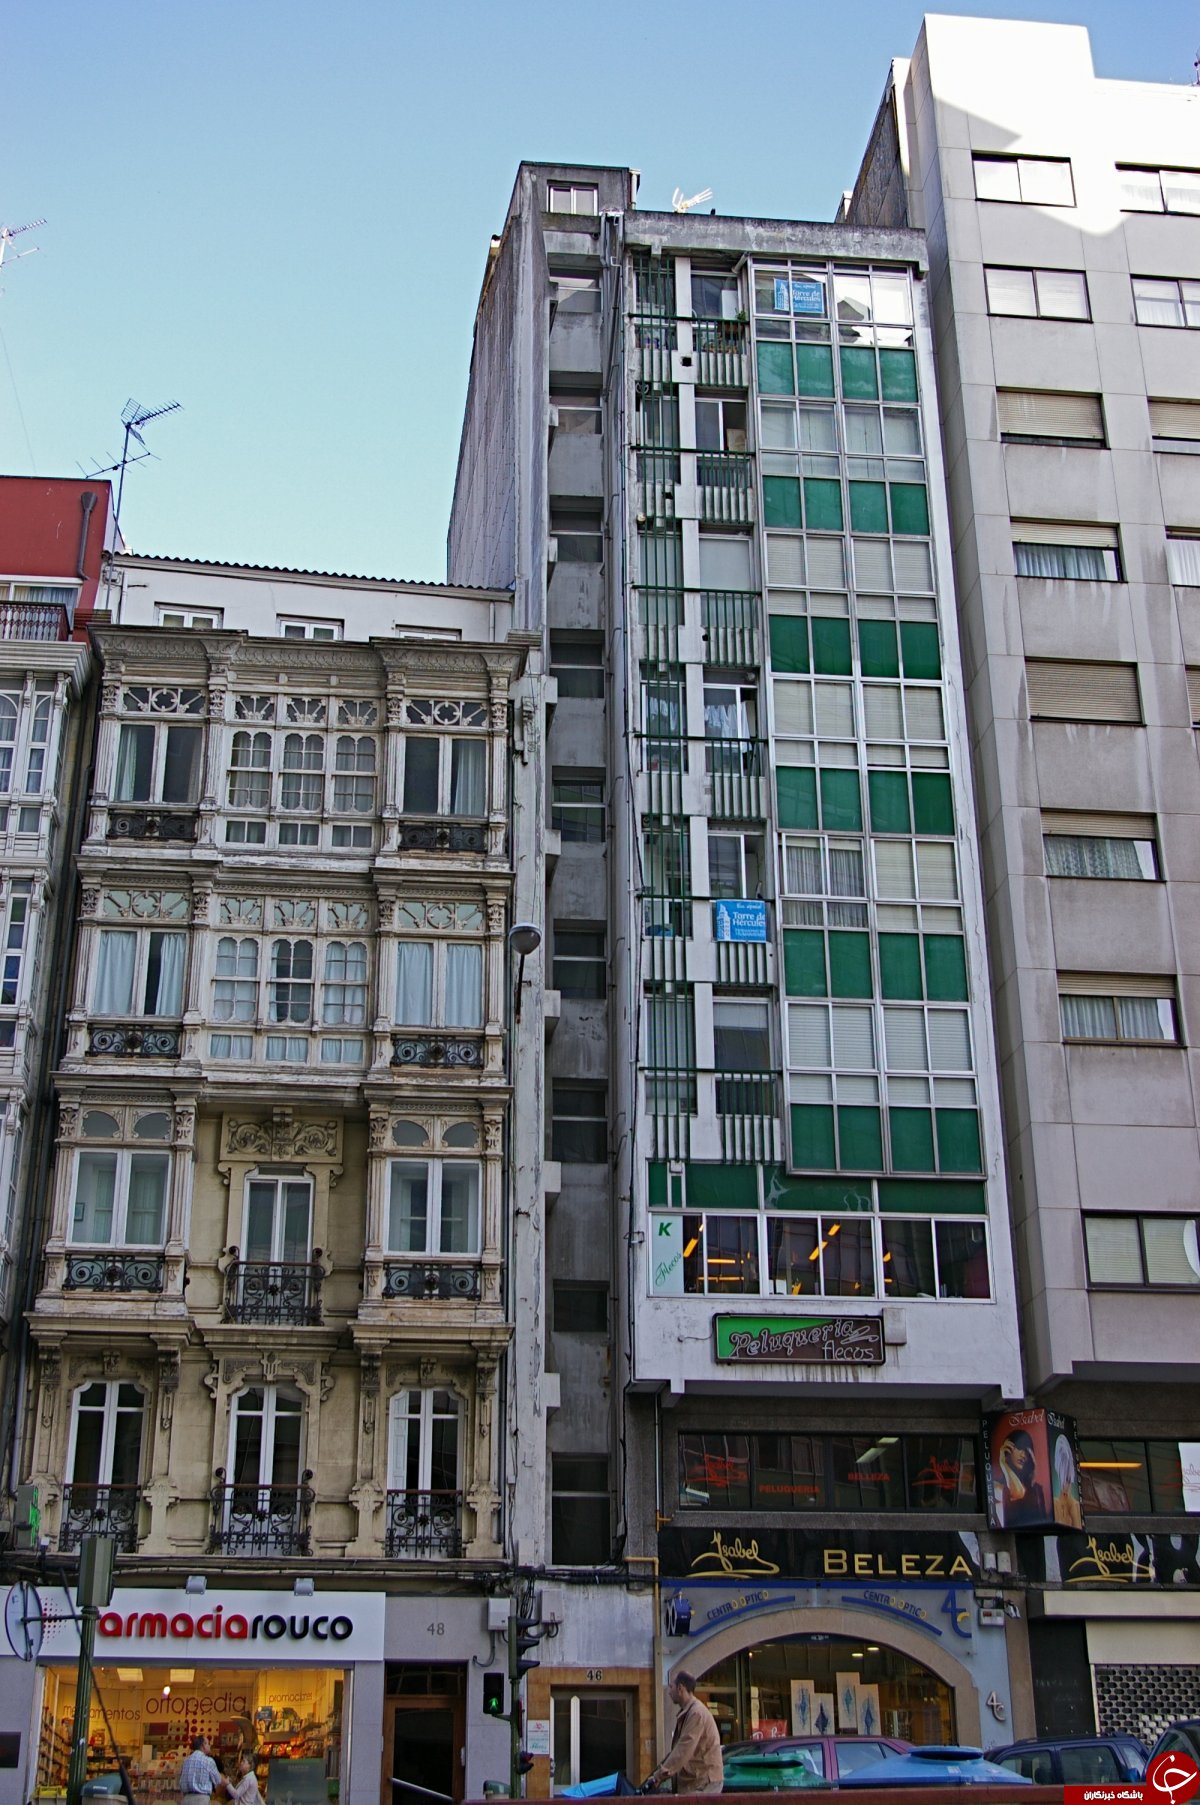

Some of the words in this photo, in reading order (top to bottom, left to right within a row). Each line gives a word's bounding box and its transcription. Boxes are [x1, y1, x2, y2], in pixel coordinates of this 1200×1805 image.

[732, 911, 755, 920] Torre
[658, 1222, 672, 1236] K
[729, 1318, 856, 1358] Peluqueria
[981, 1420, 997, 1525] PELUQUERIA
[759, 1484, 820, 1494] PELUQUERIA
[691, 1530, 773, 1574] Isabel
[1069, 1535, 1146, 1577] Isabel
[863, 1589, 896, 1607] CENTRO
[706, 1599, 738, 1620] CENTRO
[426, 1622, 445, 1636] 48
[586, 1670, 602, 1681] 46
[145, 1692, 247, 1718] ortopedia
